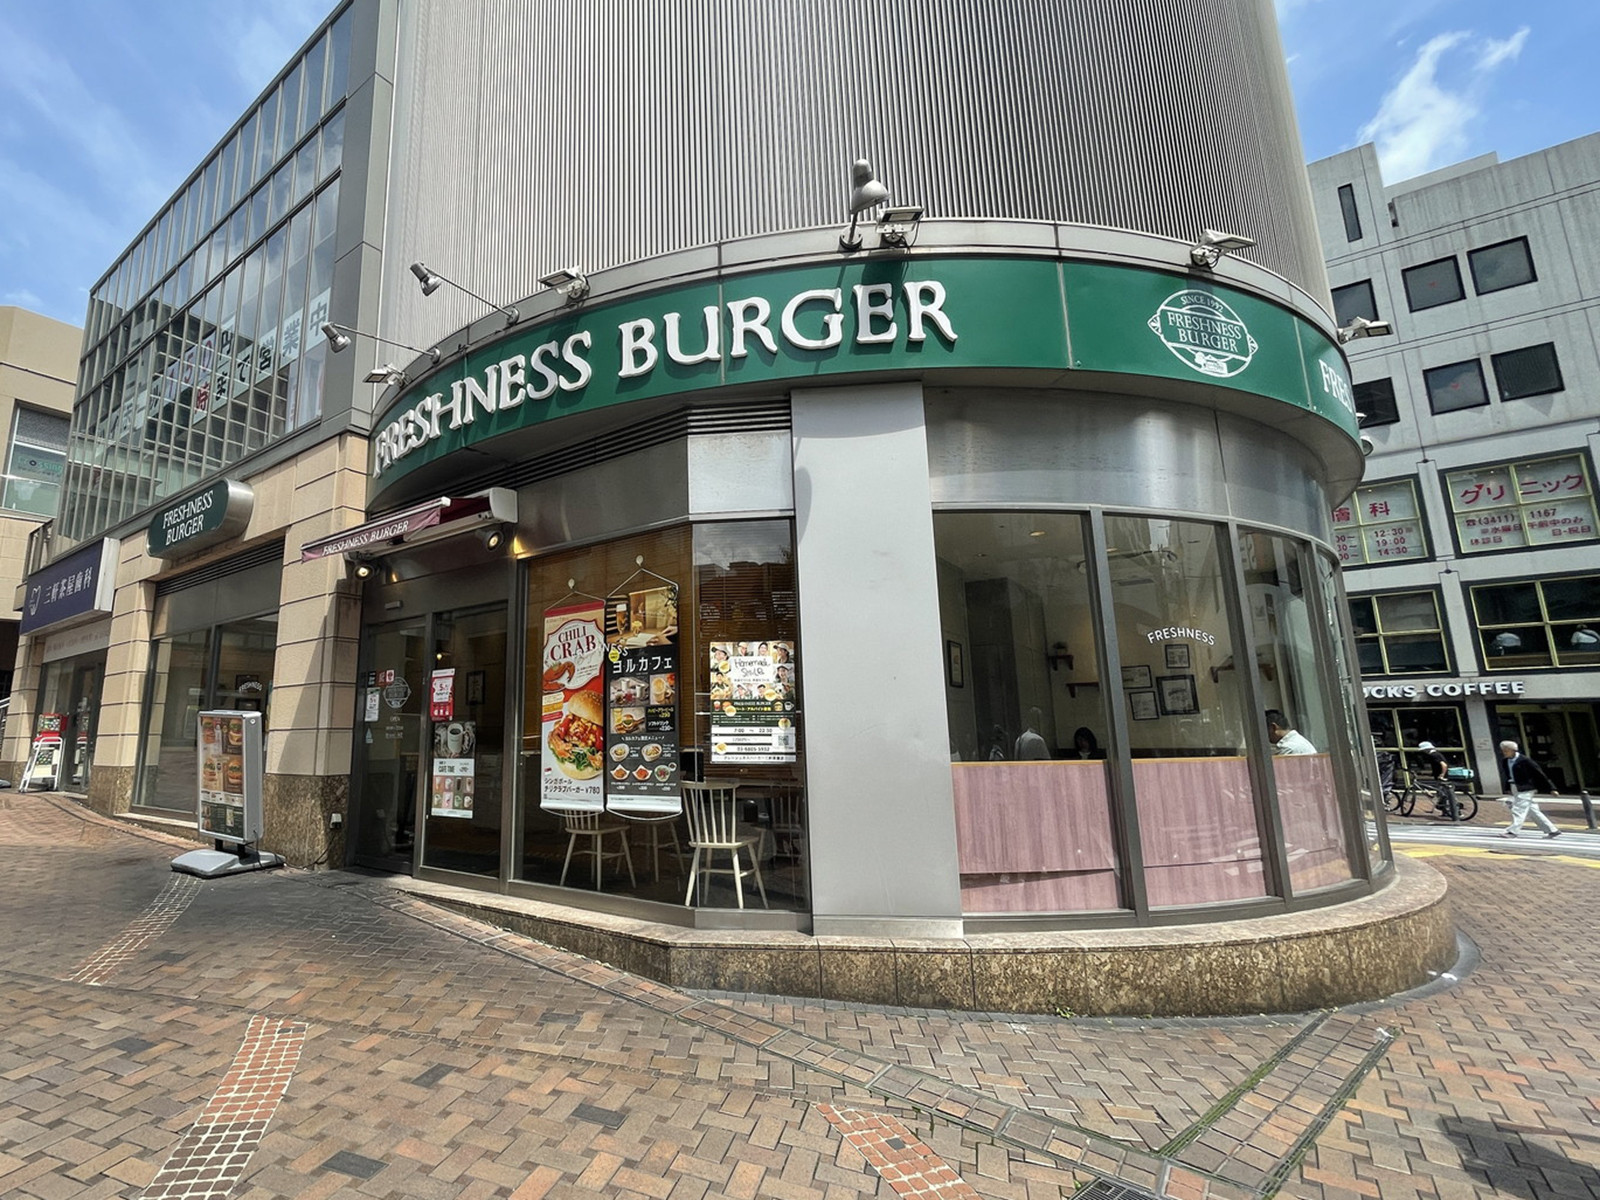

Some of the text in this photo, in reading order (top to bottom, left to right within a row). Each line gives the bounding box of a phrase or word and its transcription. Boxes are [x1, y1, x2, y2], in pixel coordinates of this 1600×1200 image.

[1180, 295, 1225, 313] SINCE 1992
[1167, 312, 1242, 340] FRESHNESS
[1178, 328, 1239, 352] BURGER
[372, 280, 959, 479] FRESHNESS BURGER
[162, 489, 213, 530] FRESHNESS
[1530, 508, 1557, 519] 1167
[165, 513, 204, 546] BURGER
[321, 520, 409, 556] FRESHNESS BURGER
[1375, 527, 1404, 538] 12:30
[1376, 536, 1406, 547] 19:00
[1378, 546, 1408, 556] 14:30
[558, 625, 587, 644] CHILI
[1147, 626, 1215, 646] FRESHNESS
[549, 634, 596, 662] CRAB
[1426, 681, 1526, 697] COFFEE
